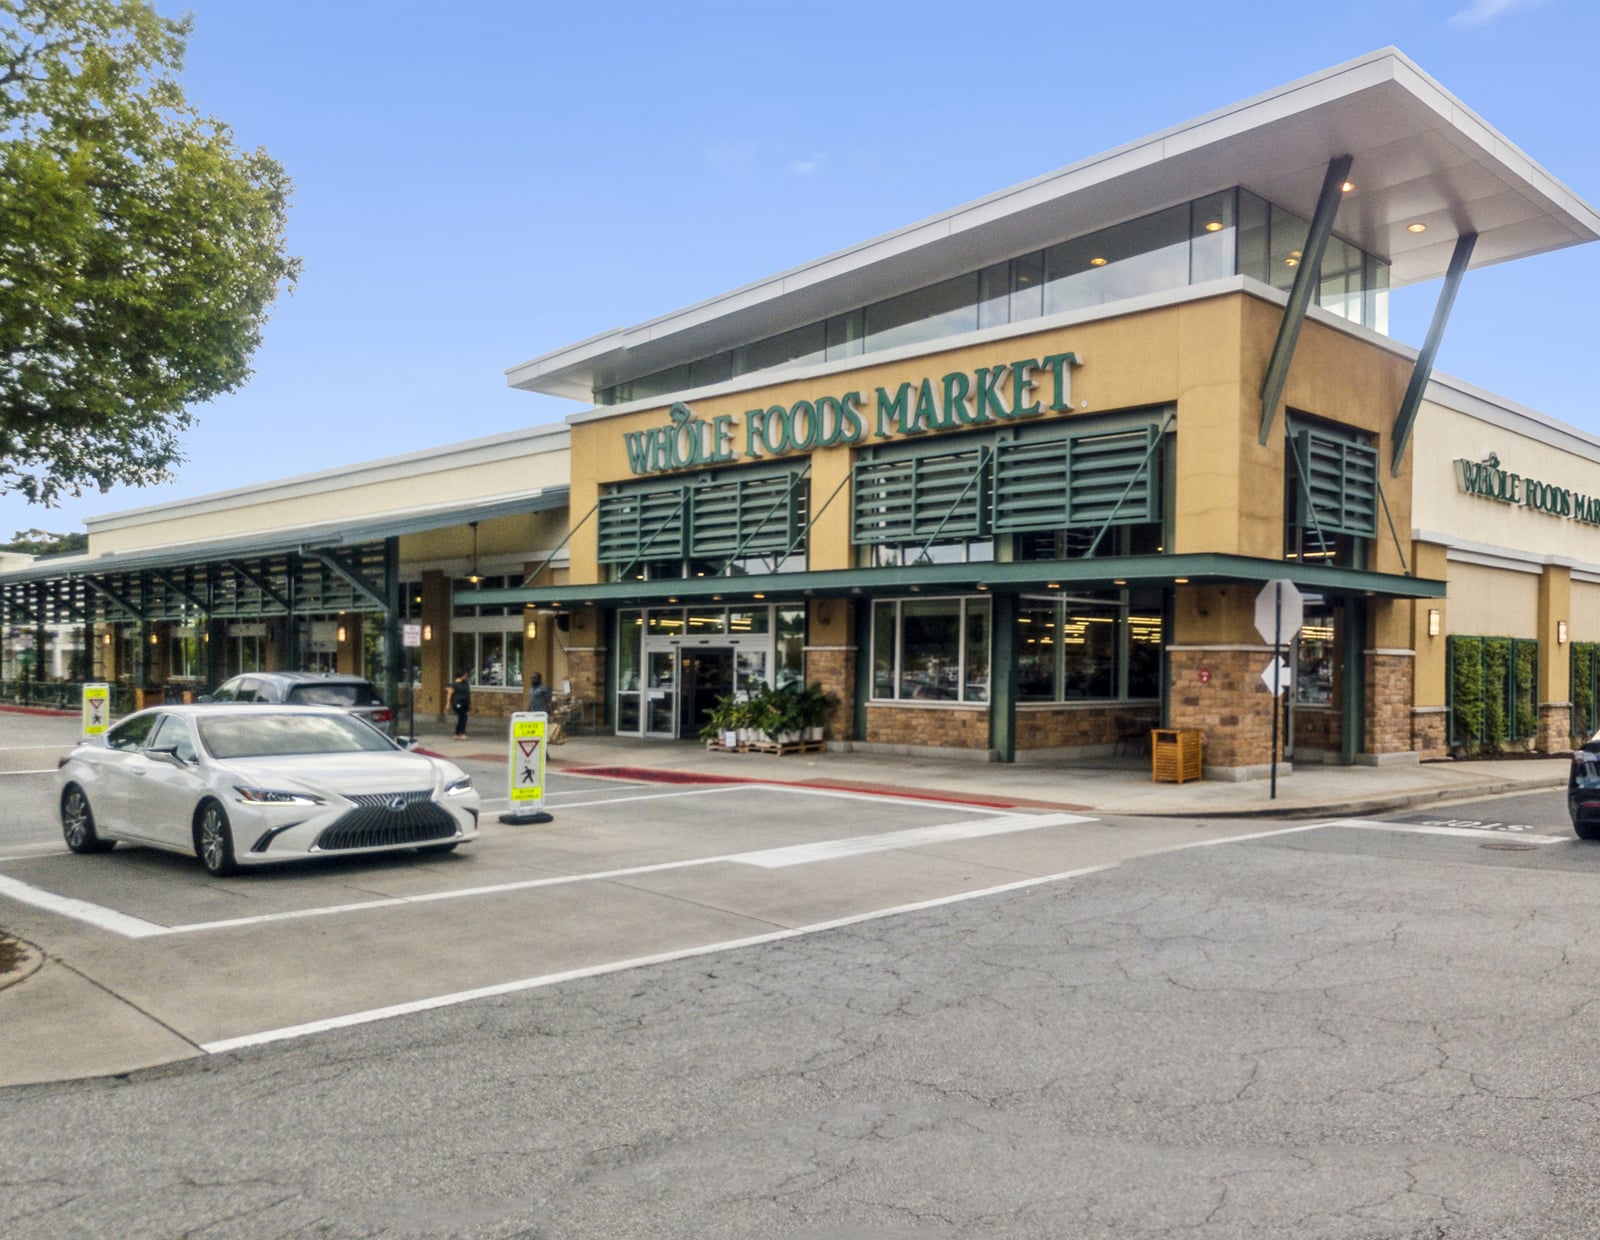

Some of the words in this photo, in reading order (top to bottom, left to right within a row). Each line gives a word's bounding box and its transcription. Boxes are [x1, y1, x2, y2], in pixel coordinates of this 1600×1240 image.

[623, 402, 738, 474] WHOLE
[744, 391, 868, 458] FOODS
[874, 352, 1083, 438] MARKET
[1454, 452, 1520, 504] WHOLE
[1522, 478, 1570, 517] FOODS
